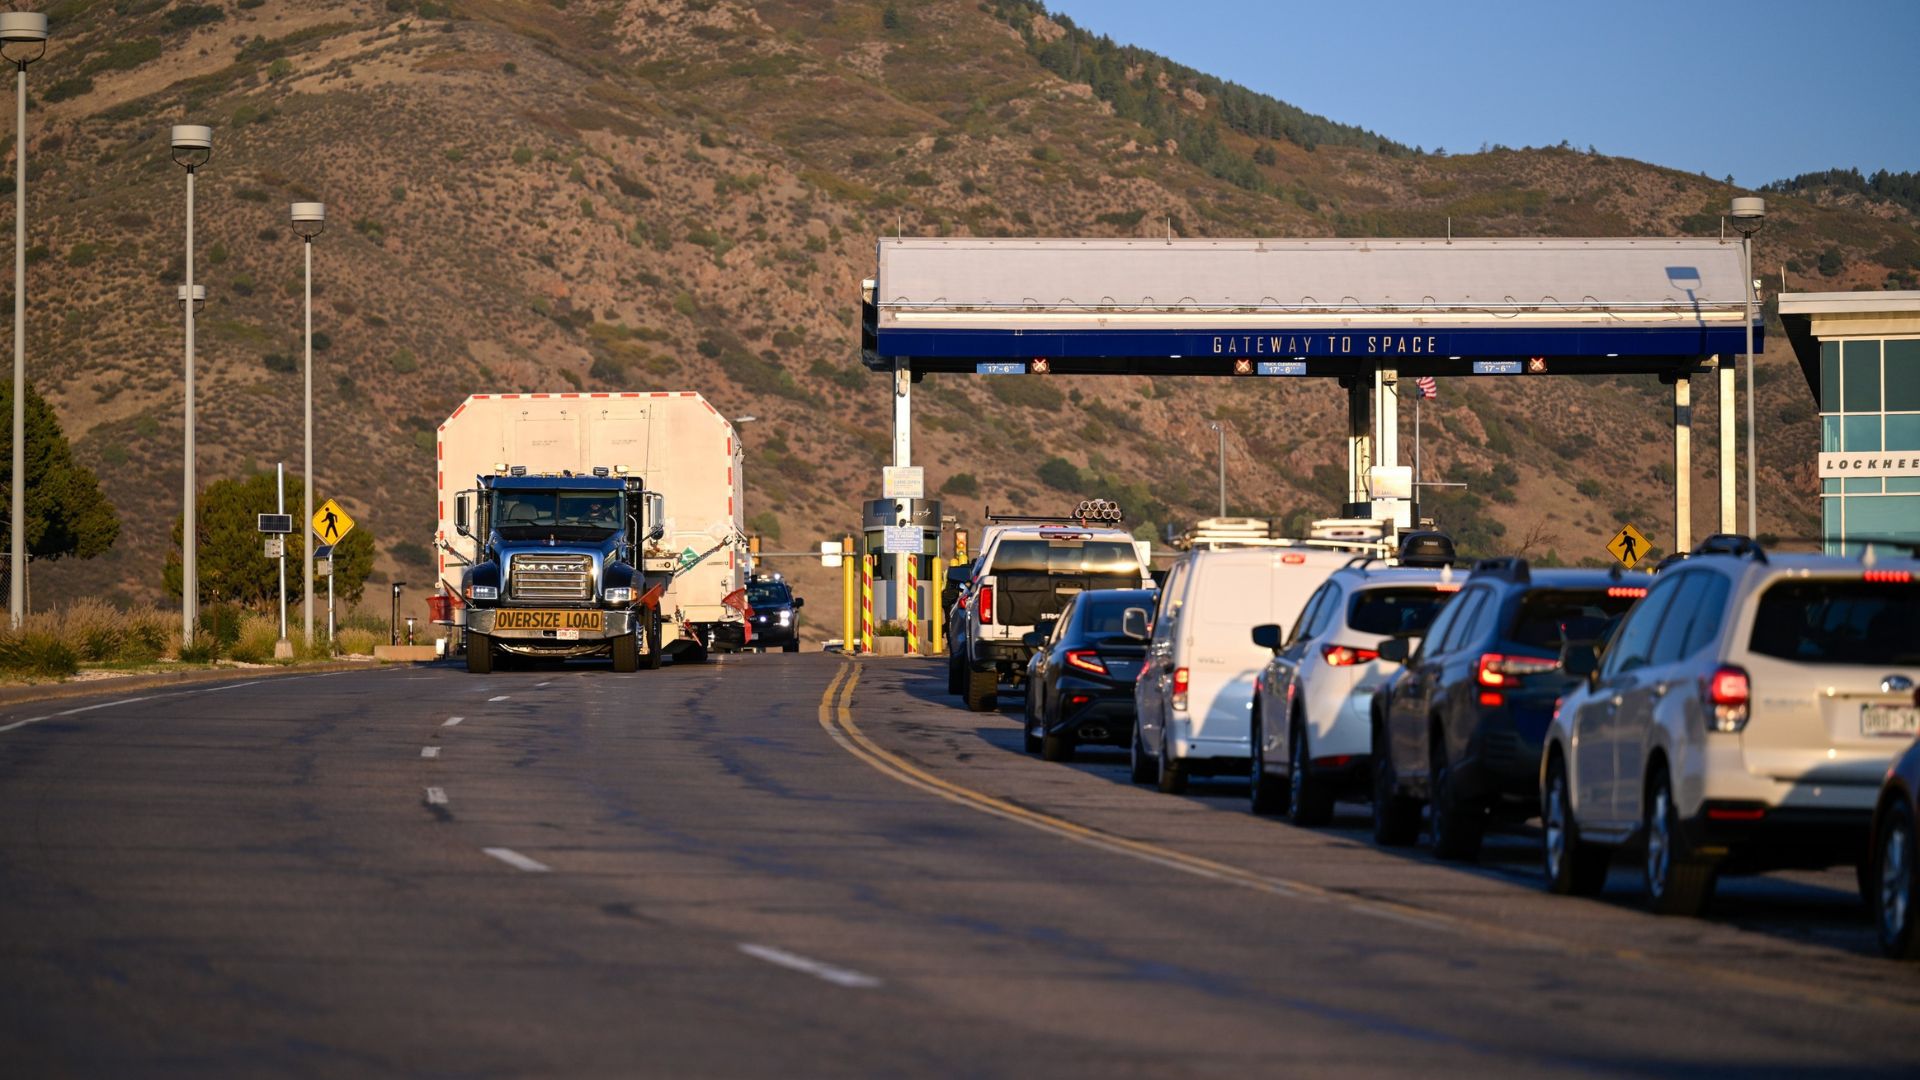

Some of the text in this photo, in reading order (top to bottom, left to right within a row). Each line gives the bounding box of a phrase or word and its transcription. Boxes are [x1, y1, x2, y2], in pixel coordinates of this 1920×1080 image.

[1213, 336, 1435, 353] GATEWAY TO SPACE
[1826, 459, 1920, 469] LOCKHEE
[519, 564, 585, 572] MACK
[498, 611, 600, 629] OVERSIZE LOAD
